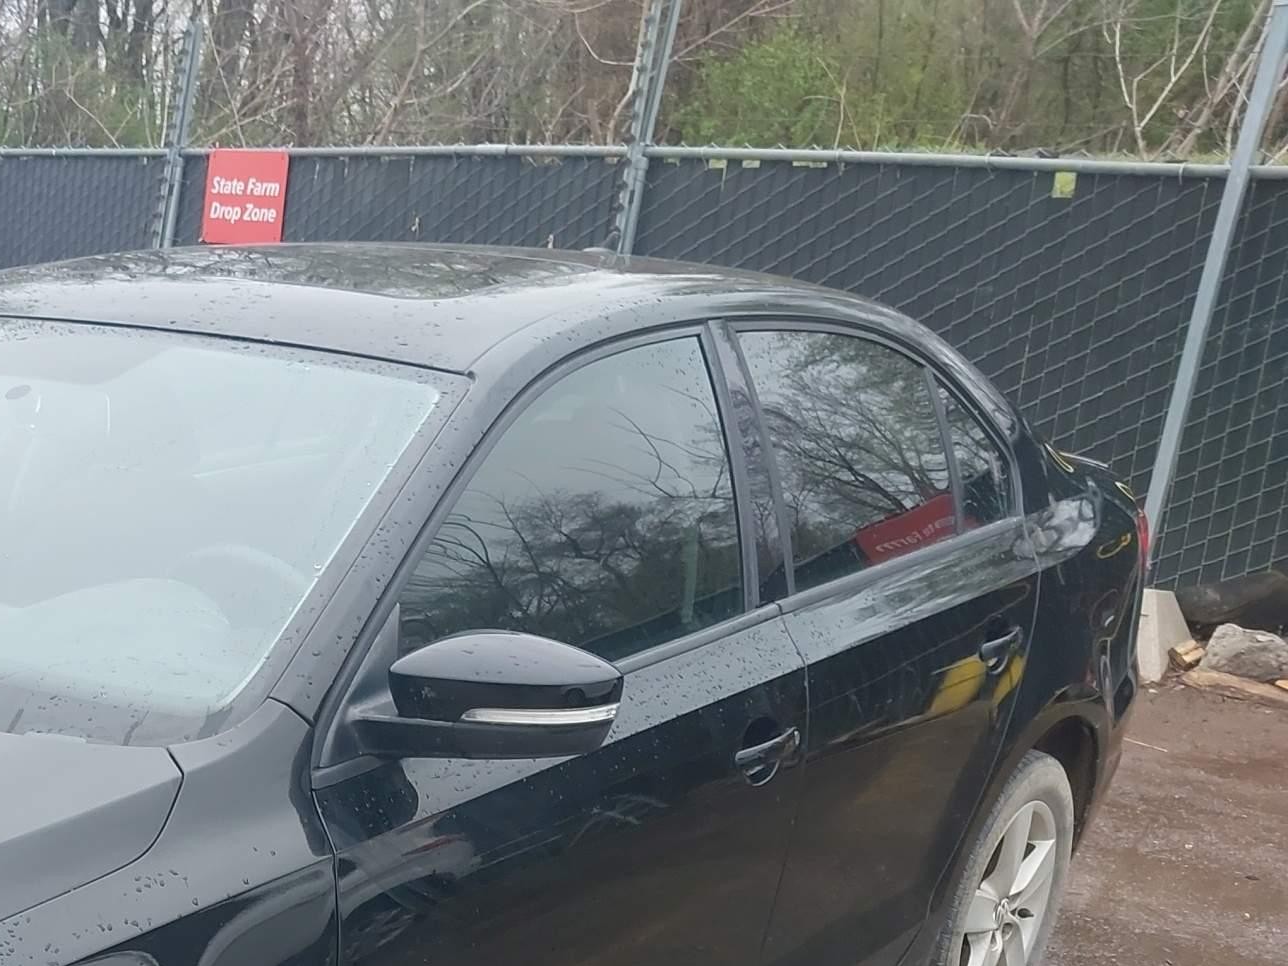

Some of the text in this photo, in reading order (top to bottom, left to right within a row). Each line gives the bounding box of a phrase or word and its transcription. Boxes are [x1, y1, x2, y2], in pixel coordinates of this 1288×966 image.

[211, 176, 280, 197] State Farm
[210, 202, 277, 224] Drop Zone
